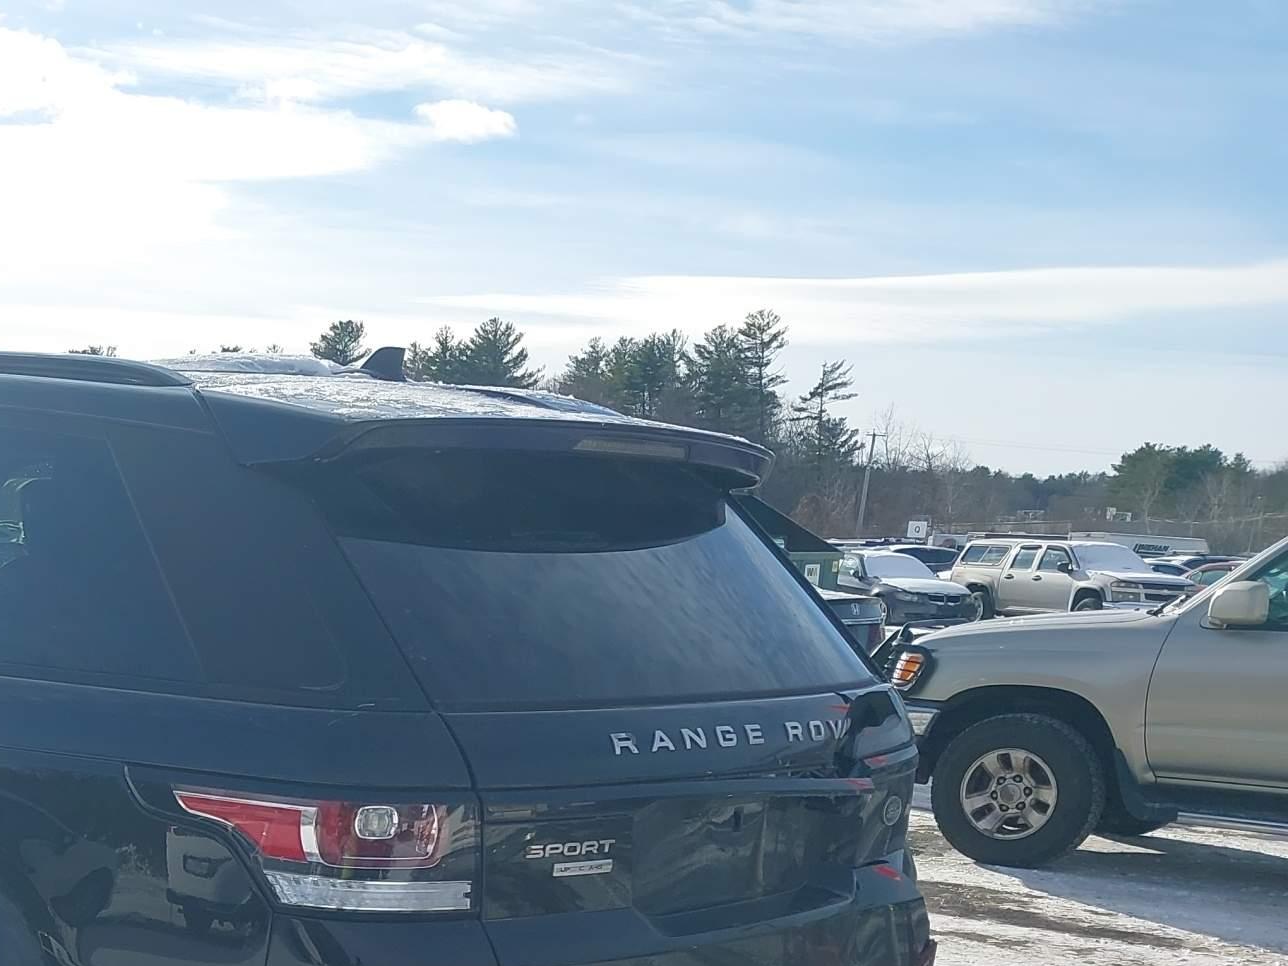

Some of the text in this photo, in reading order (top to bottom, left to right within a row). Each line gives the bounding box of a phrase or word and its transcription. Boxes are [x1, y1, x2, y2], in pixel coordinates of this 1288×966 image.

[609, 718, 852, 755] RANGE ROV
[525, 839, 616, 859] SPORT
